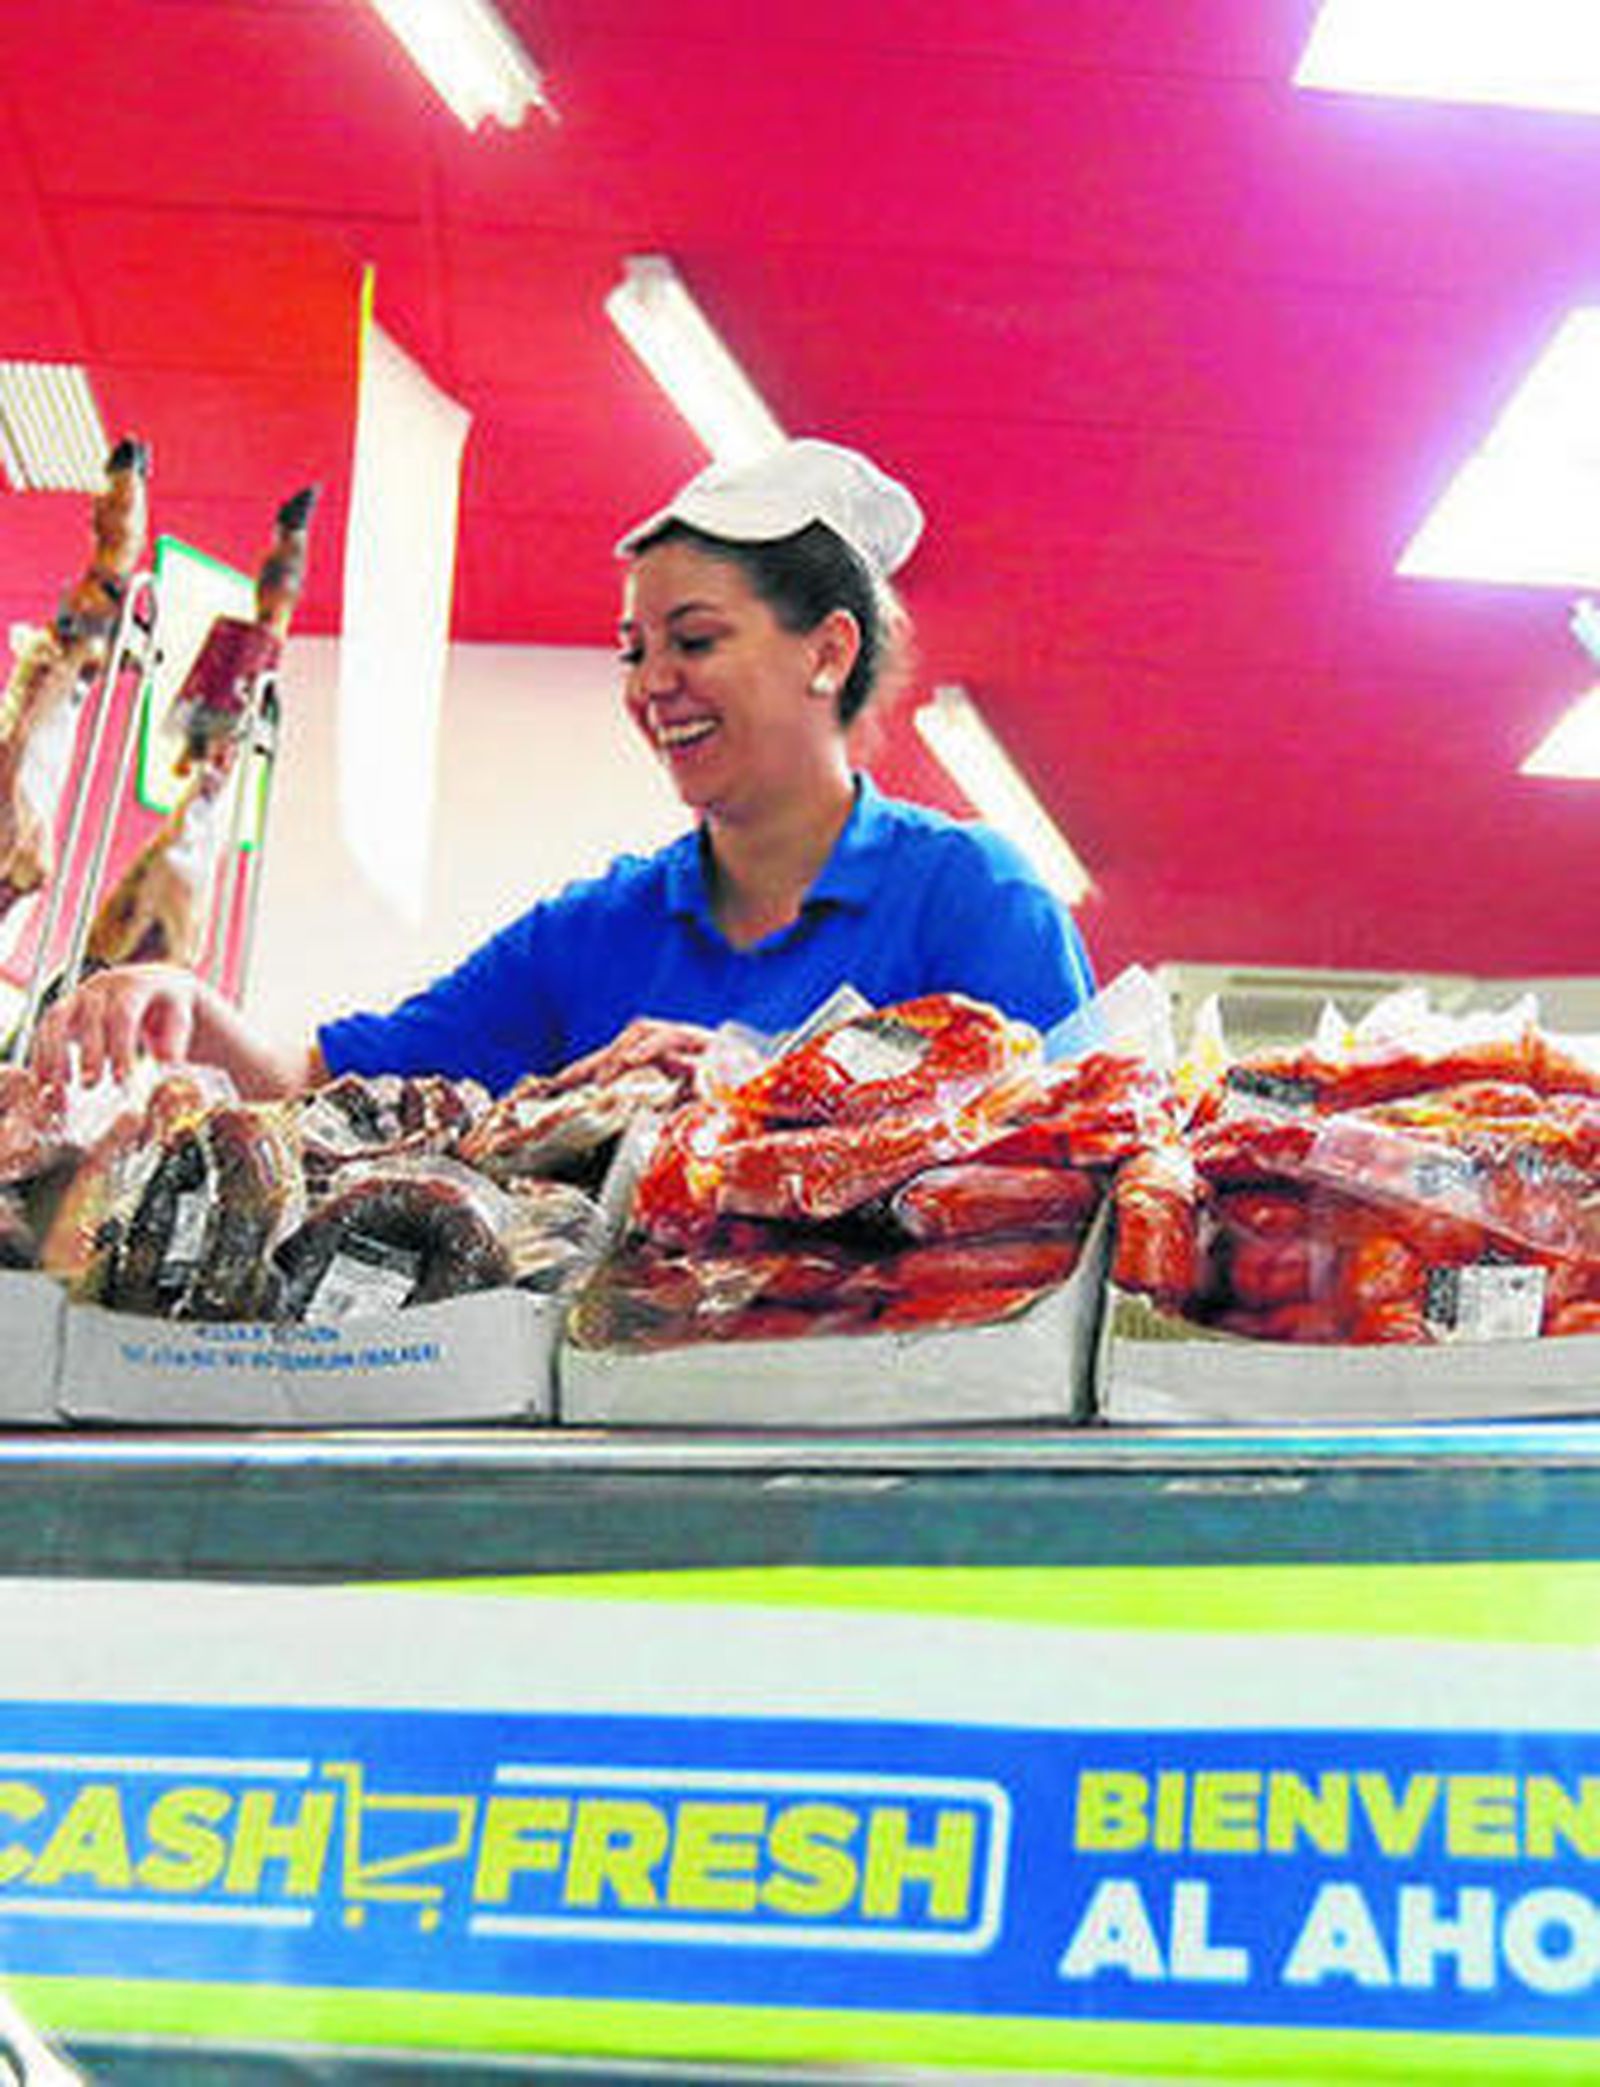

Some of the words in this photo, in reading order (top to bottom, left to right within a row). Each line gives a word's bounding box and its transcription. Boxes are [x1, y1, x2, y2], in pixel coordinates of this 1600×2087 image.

[473, 1794, 976, 1921] FRESH
[1074, 1771, 1600, 1858] BIENVEN
[1058, 1880, 1249, 1982] AL
[1281, 1883, 1600, 1993] AHO
